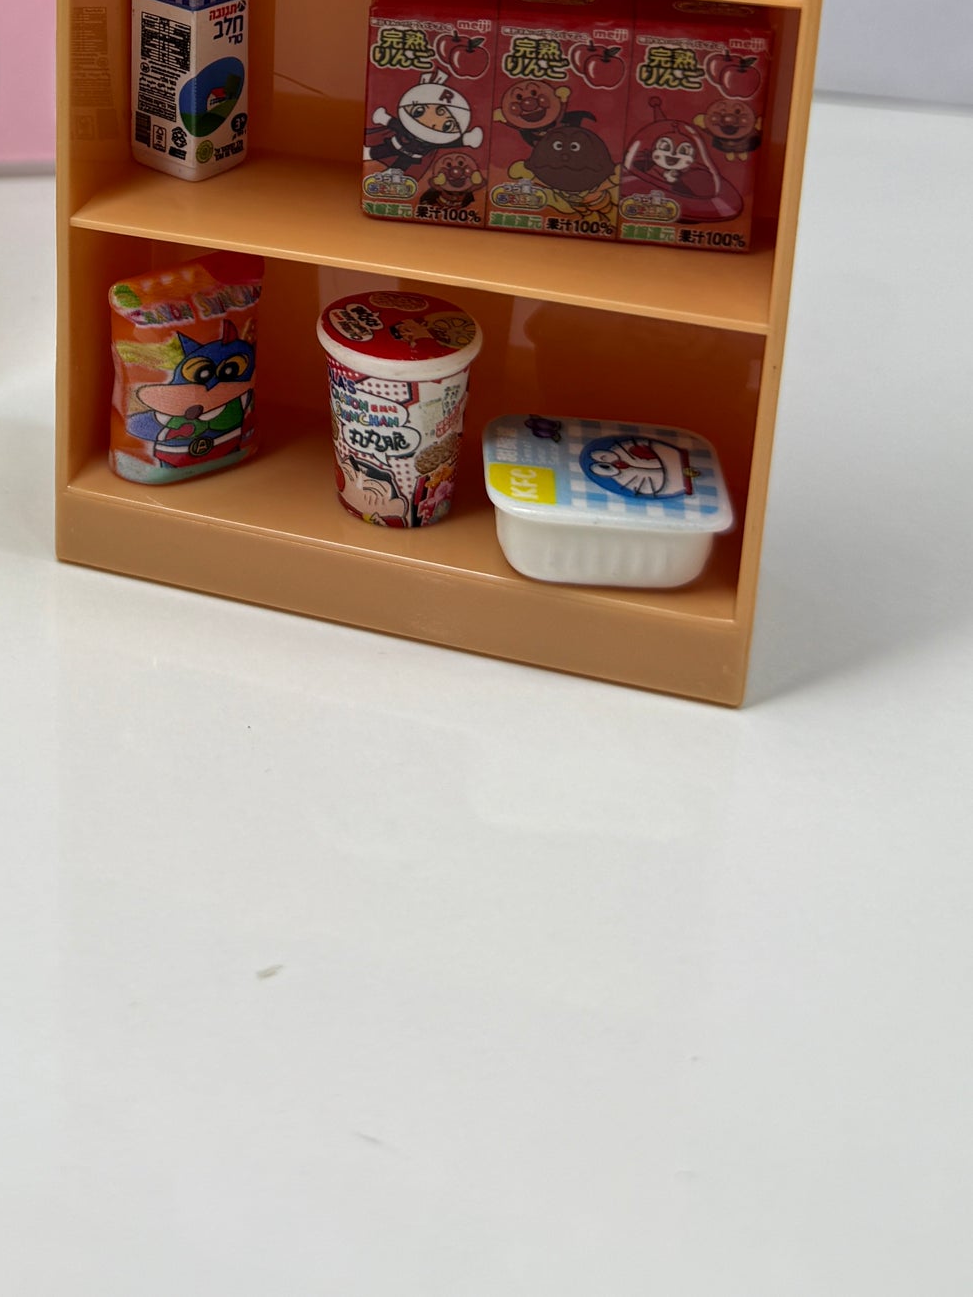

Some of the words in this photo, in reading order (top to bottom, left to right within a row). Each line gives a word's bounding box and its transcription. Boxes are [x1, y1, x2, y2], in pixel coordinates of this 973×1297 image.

[213, 15, 243, 40] חלב
[457, 20, 491, 32] meiji
[593, 29, 629, 42] meiji
[381, 29, 427, 50] 完熟
[514, 38, 562, 60] 完熟
[730, 39, 766, 52] meiji
[373, 46, 435, 69] りんご
[505, 55, 570, 79] りんご
[649, 47, 697, 70] 完熟
[639, 65, 705, 89] りんご
[439, 89, 454, 103] R
[415, 206, 482, 223] 果汁100%
[545, 217, 615, 236] 果汁100%
[678, 229, 746, 248] 果汁100%
[348, 428, 411, 452] 丸丸脆
[510, 468, 539, 500] KFC
